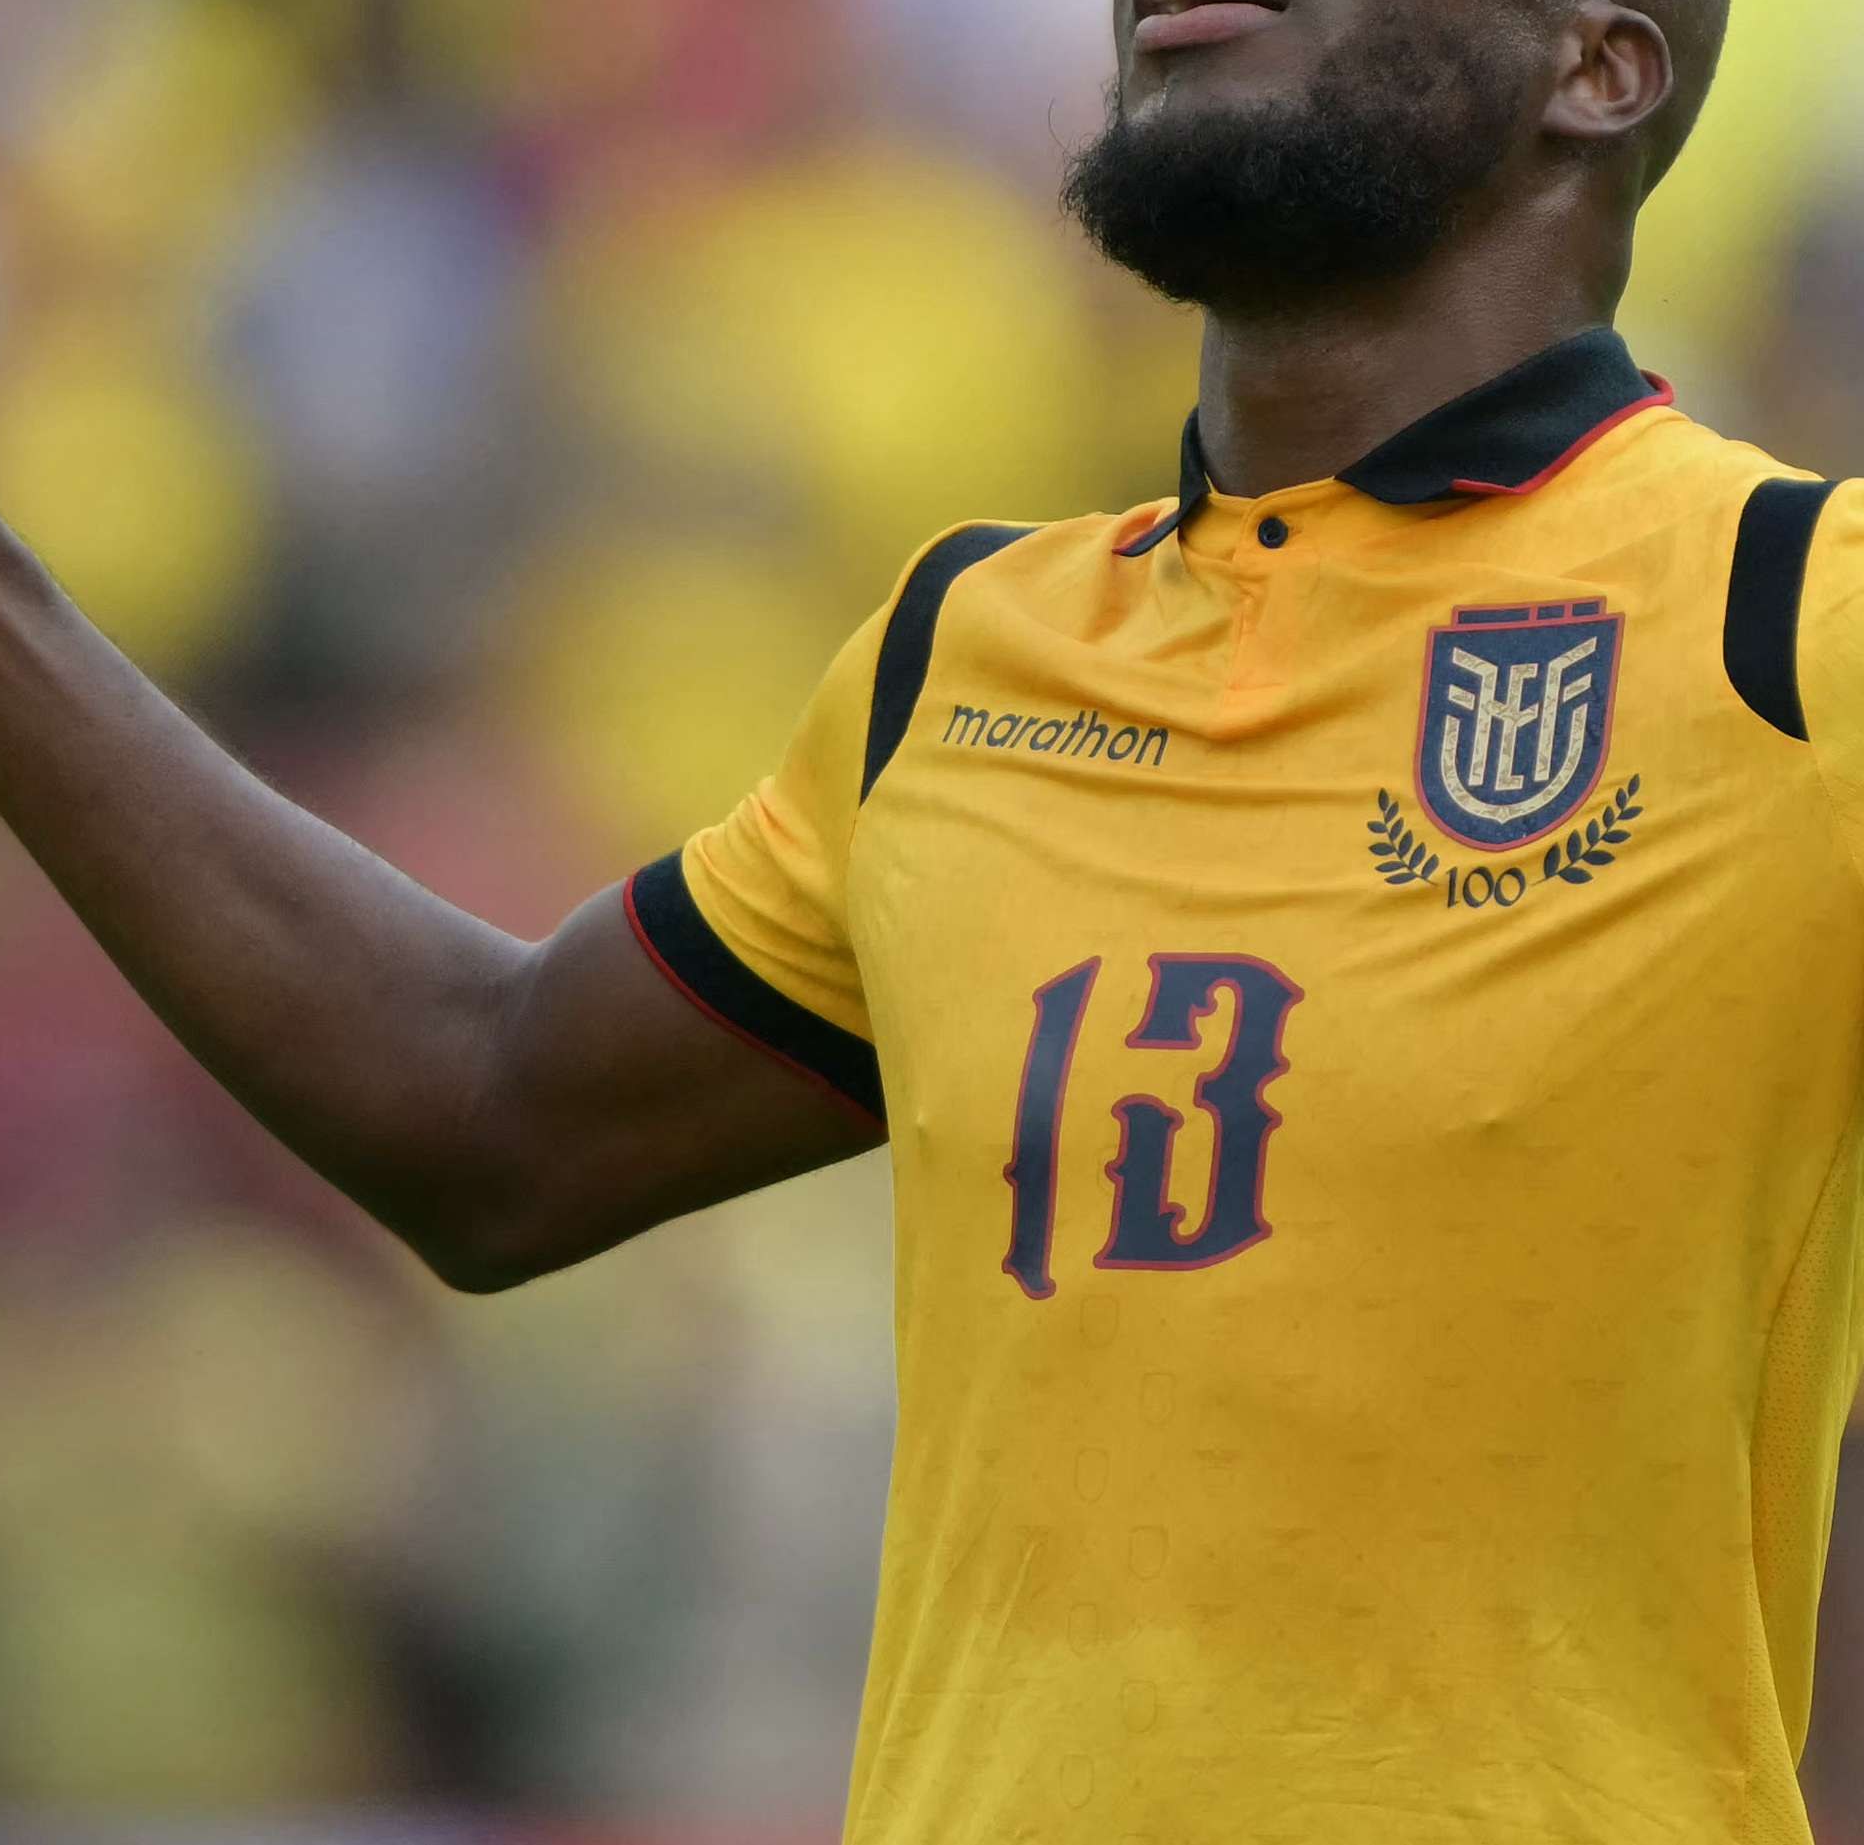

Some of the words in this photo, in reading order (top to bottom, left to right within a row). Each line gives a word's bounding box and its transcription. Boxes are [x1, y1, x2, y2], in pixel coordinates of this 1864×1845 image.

[941, 703, 1170, 768] marathon
[1445, 865, 1527, 909] 100
[1001, 952, 1306, 1301] 13
